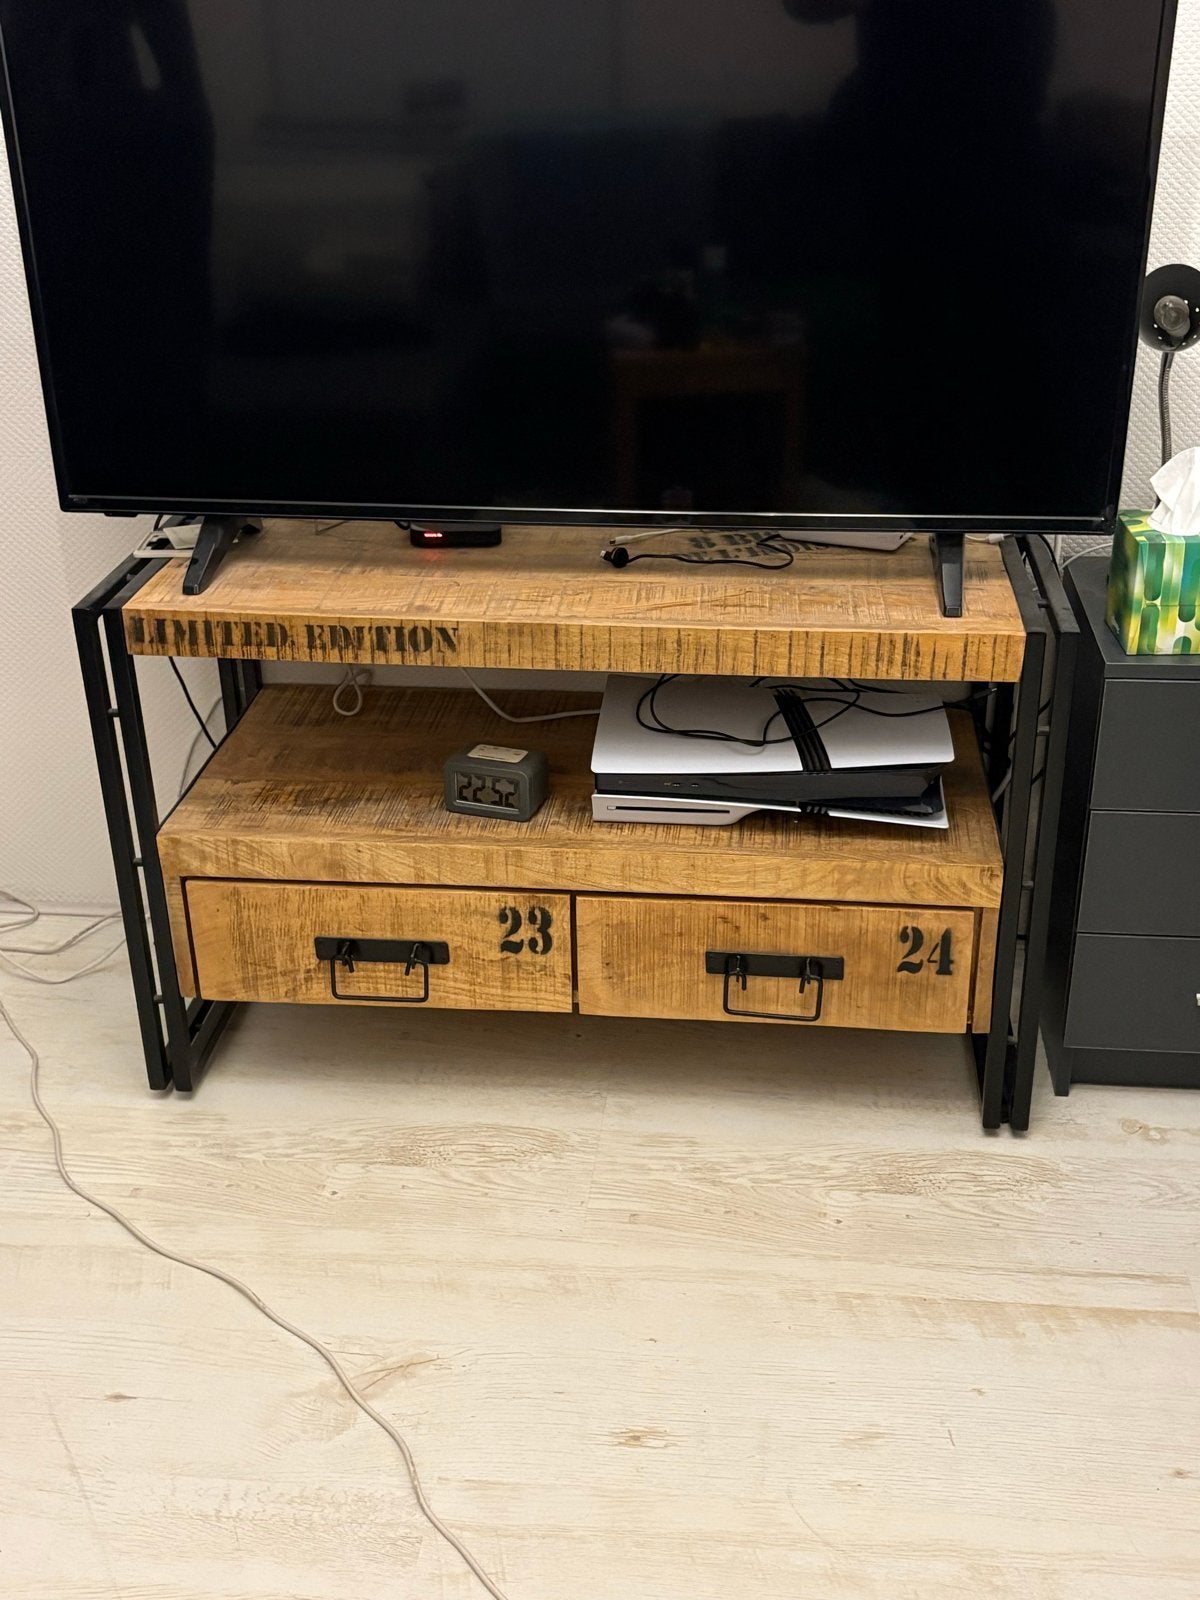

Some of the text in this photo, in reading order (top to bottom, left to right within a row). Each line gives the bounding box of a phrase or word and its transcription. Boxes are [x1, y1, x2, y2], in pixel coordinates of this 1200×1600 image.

[130, 616, 459, 652] LIMITED EDITION
[499, 906, 553, 955] 23
[897, 926, 954, 976] 24
